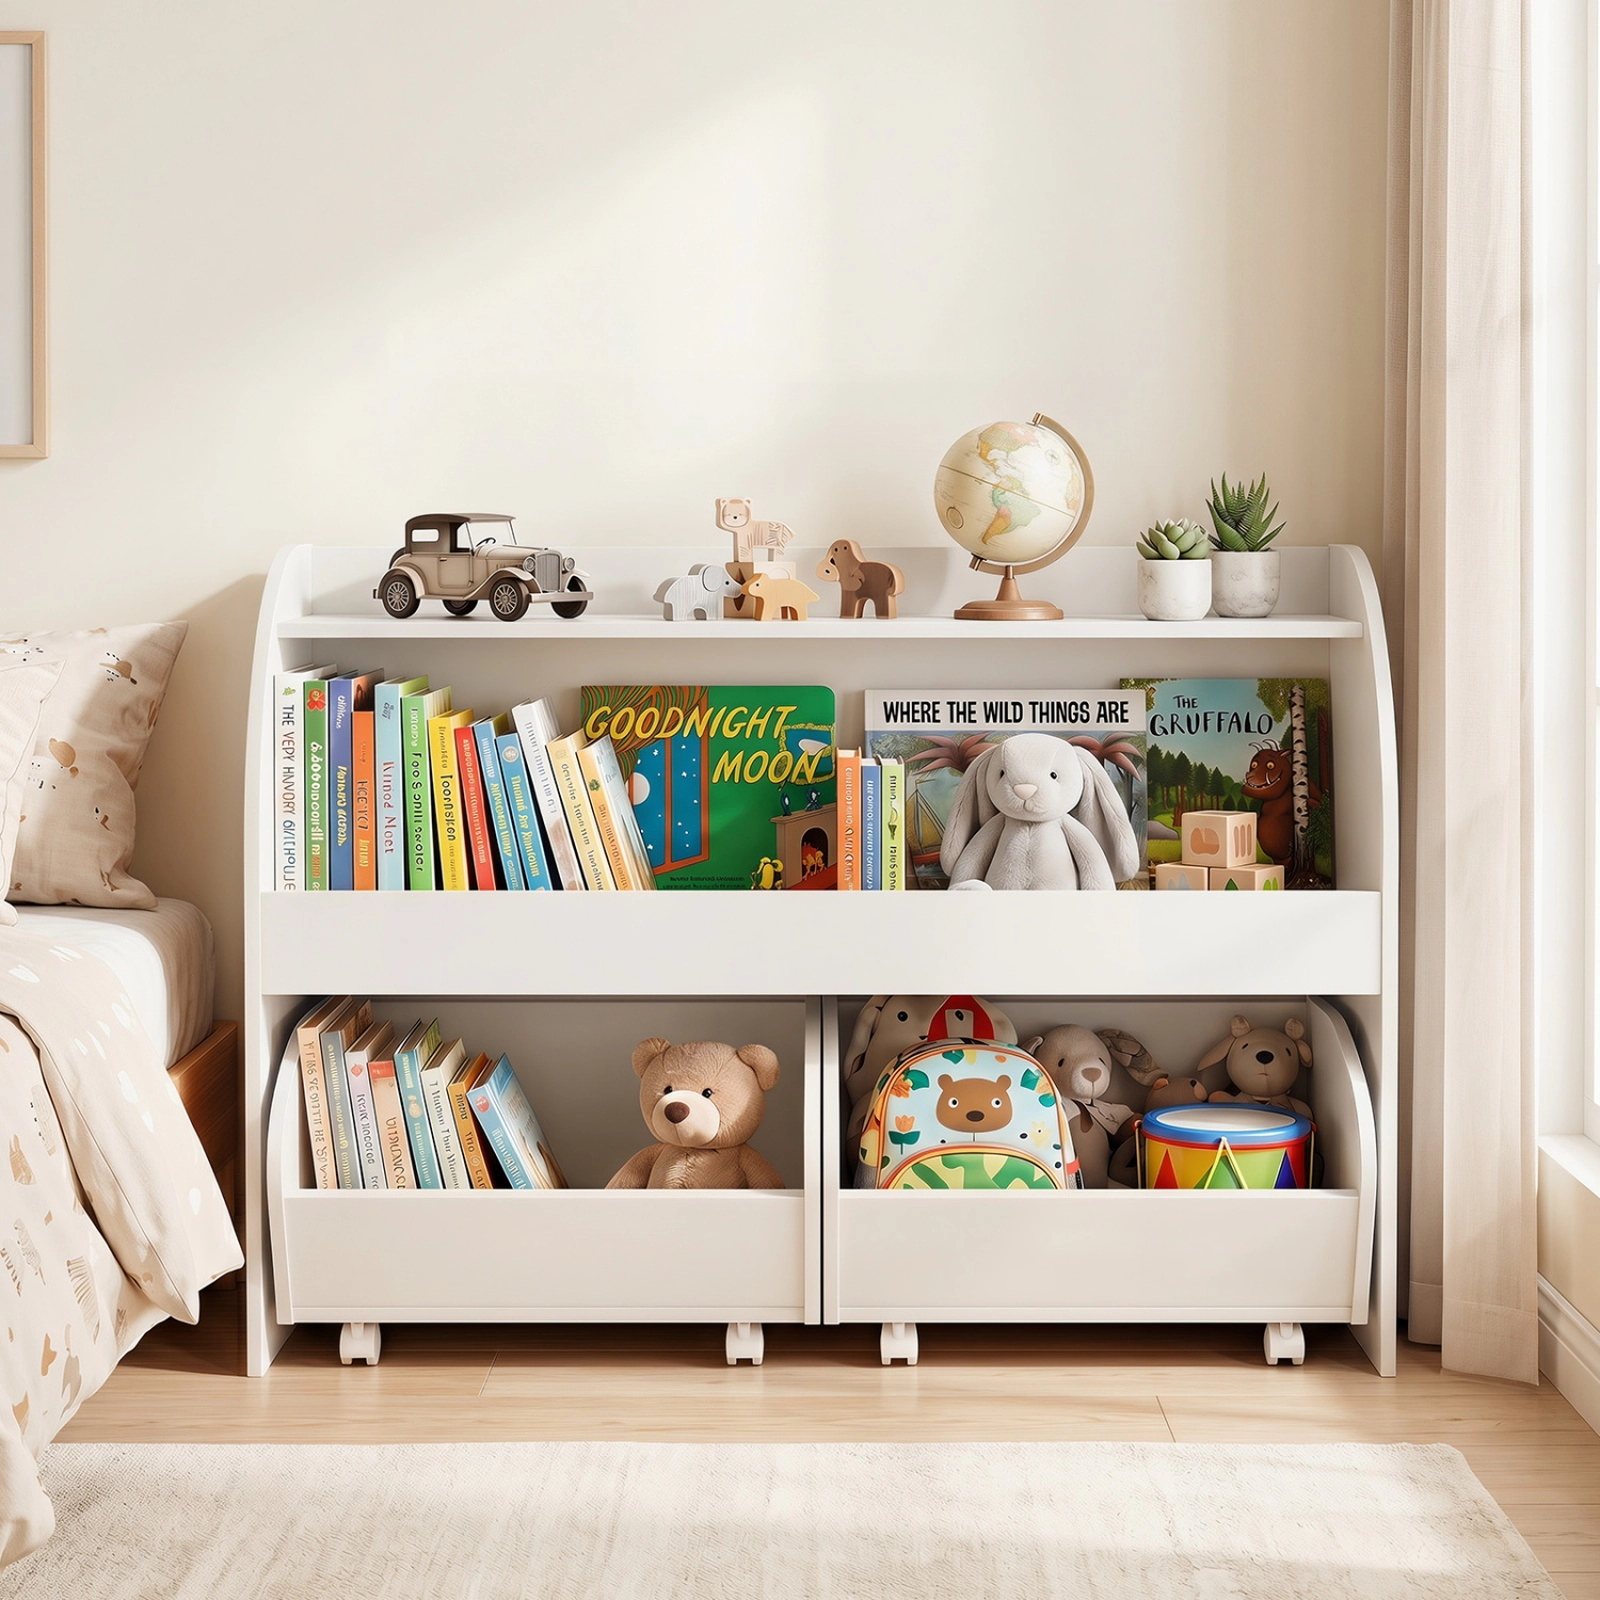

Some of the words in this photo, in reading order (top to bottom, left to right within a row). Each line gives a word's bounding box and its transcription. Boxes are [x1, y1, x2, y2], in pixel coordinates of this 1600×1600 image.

[883, 701, 941, 724] WHERE
[946, 701, 977, 724] THE
[983, 701, 1023, 724] WILD
[1029, 701, 1090, 724] THINGS
[1097, 701, 1129, 724] ARE
[1173, 694, 1198, 709] THE
[282, 704, 295, 726] THE
[586, 706, 798, 740] GOODNIGHT
[1149, 710, 1274, 737] GRUFFALO
[712, 750, 821, 784] MOON
